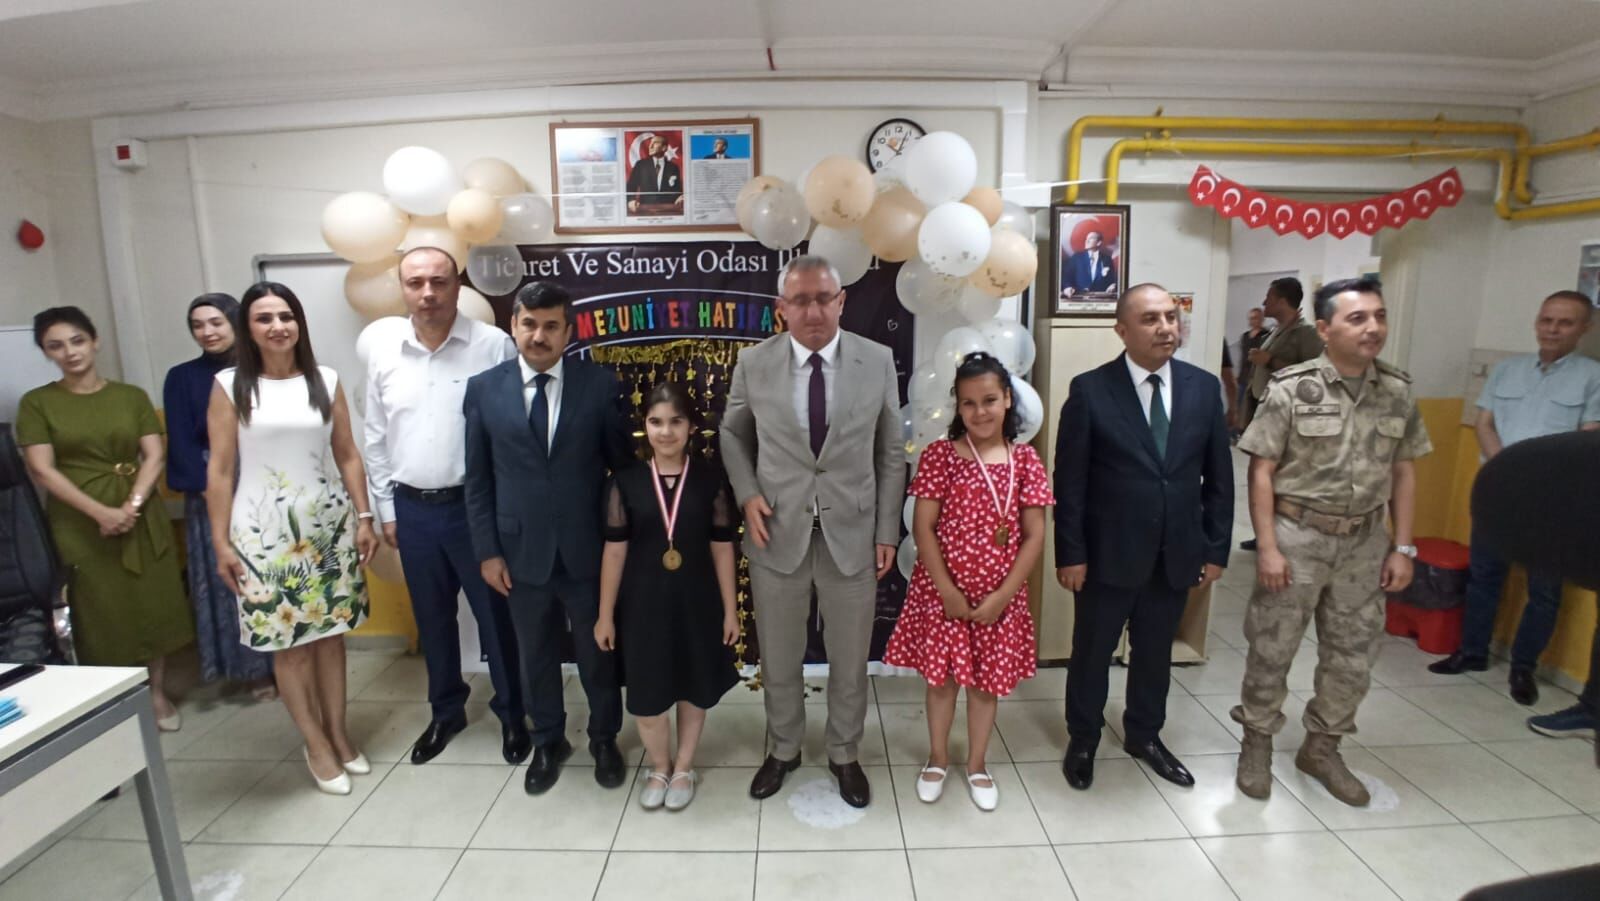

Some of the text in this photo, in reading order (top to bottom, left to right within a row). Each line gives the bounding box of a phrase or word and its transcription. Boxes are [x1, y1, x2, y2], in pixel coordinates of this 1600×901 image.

[566, 252, 598, 275] Ve
[606, 250, 689, 280] Sanayi
[696, 246, 768, 273] Odası
[576, 297, 785, 340] MEZUNİYET HATIRAS
